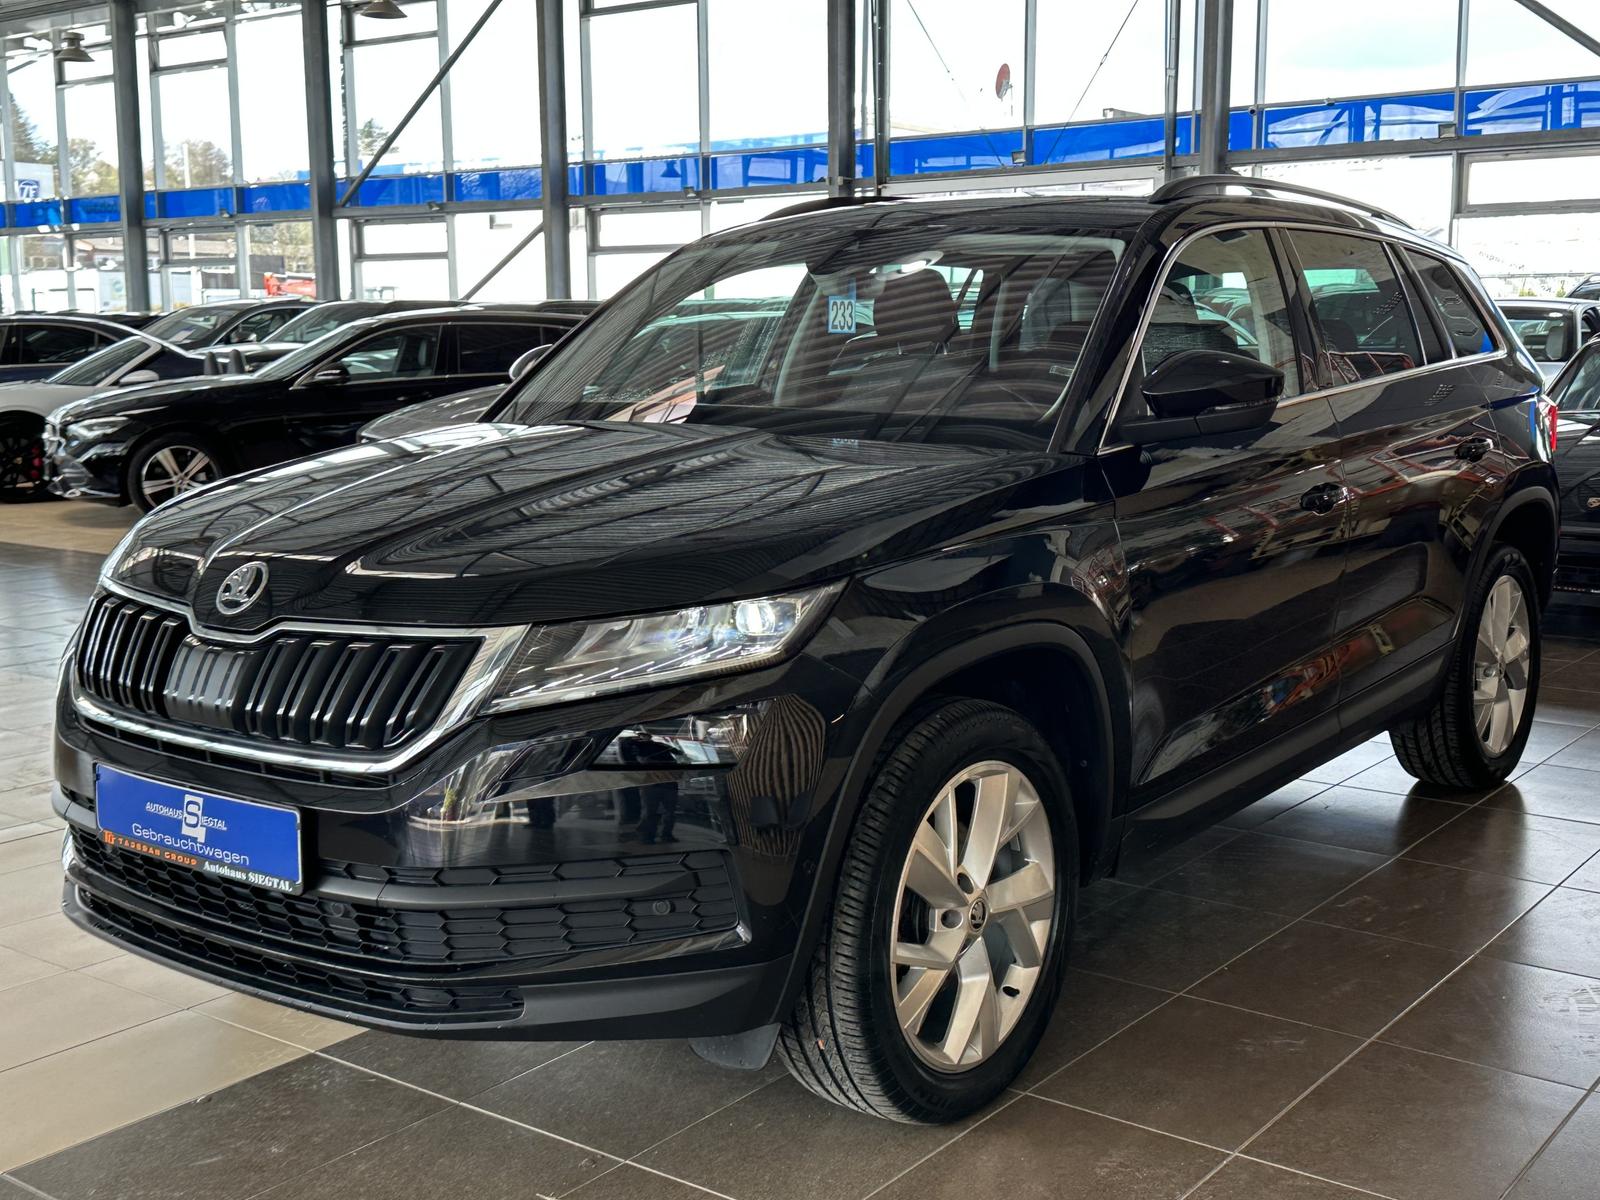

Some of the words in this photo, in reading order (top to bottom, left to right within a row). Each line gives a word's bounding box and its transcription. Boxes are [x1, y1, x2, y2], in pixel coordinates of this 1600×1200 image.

[831, 301, 853, 331] 233
[146, 801, 183, 820] AUTOHAUS
[132, 823, 250, 866] Gebrauchtwagen
[164, 851, 197, 865] GROUP
[203, 861, 246, 880] Autohaus
[248, 872, 293, 892] SIEGTAL
